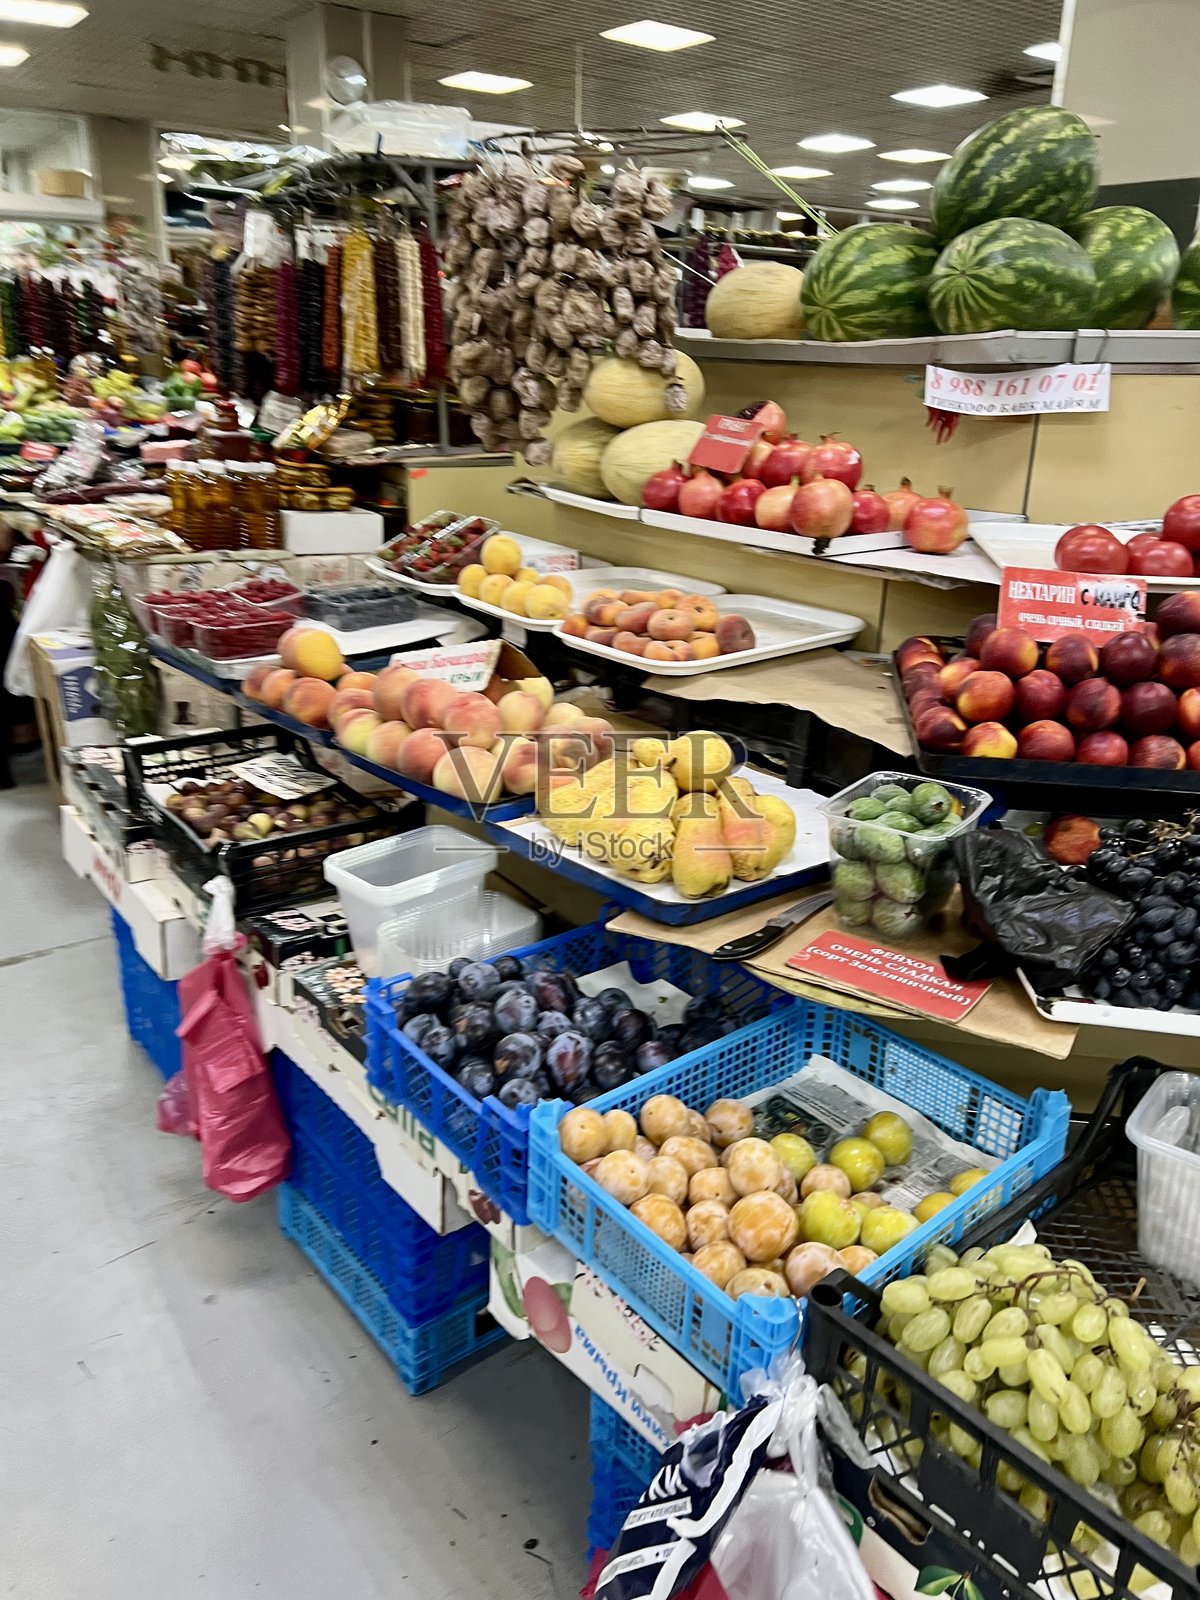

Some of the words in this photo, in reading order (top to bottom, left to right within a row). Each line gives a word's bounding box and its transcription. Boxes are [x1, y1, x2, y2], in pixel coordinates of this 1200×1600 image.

[929, 372, 943, 390] 8
[949, 377, 987, 397] 988
[993, 377, 1031, 397] 161
[1038, 374, 1069, 393] 07
[1072, 372, 1101, 392] 01
[1008, 580, 1077, 605] НЕКТАРИН
[806, 946, 849, 966] (сорт
[830, 944, 883, 966] ОЧЕНЬ
[885, 962, 964, 992] СЛАДКАЯ
